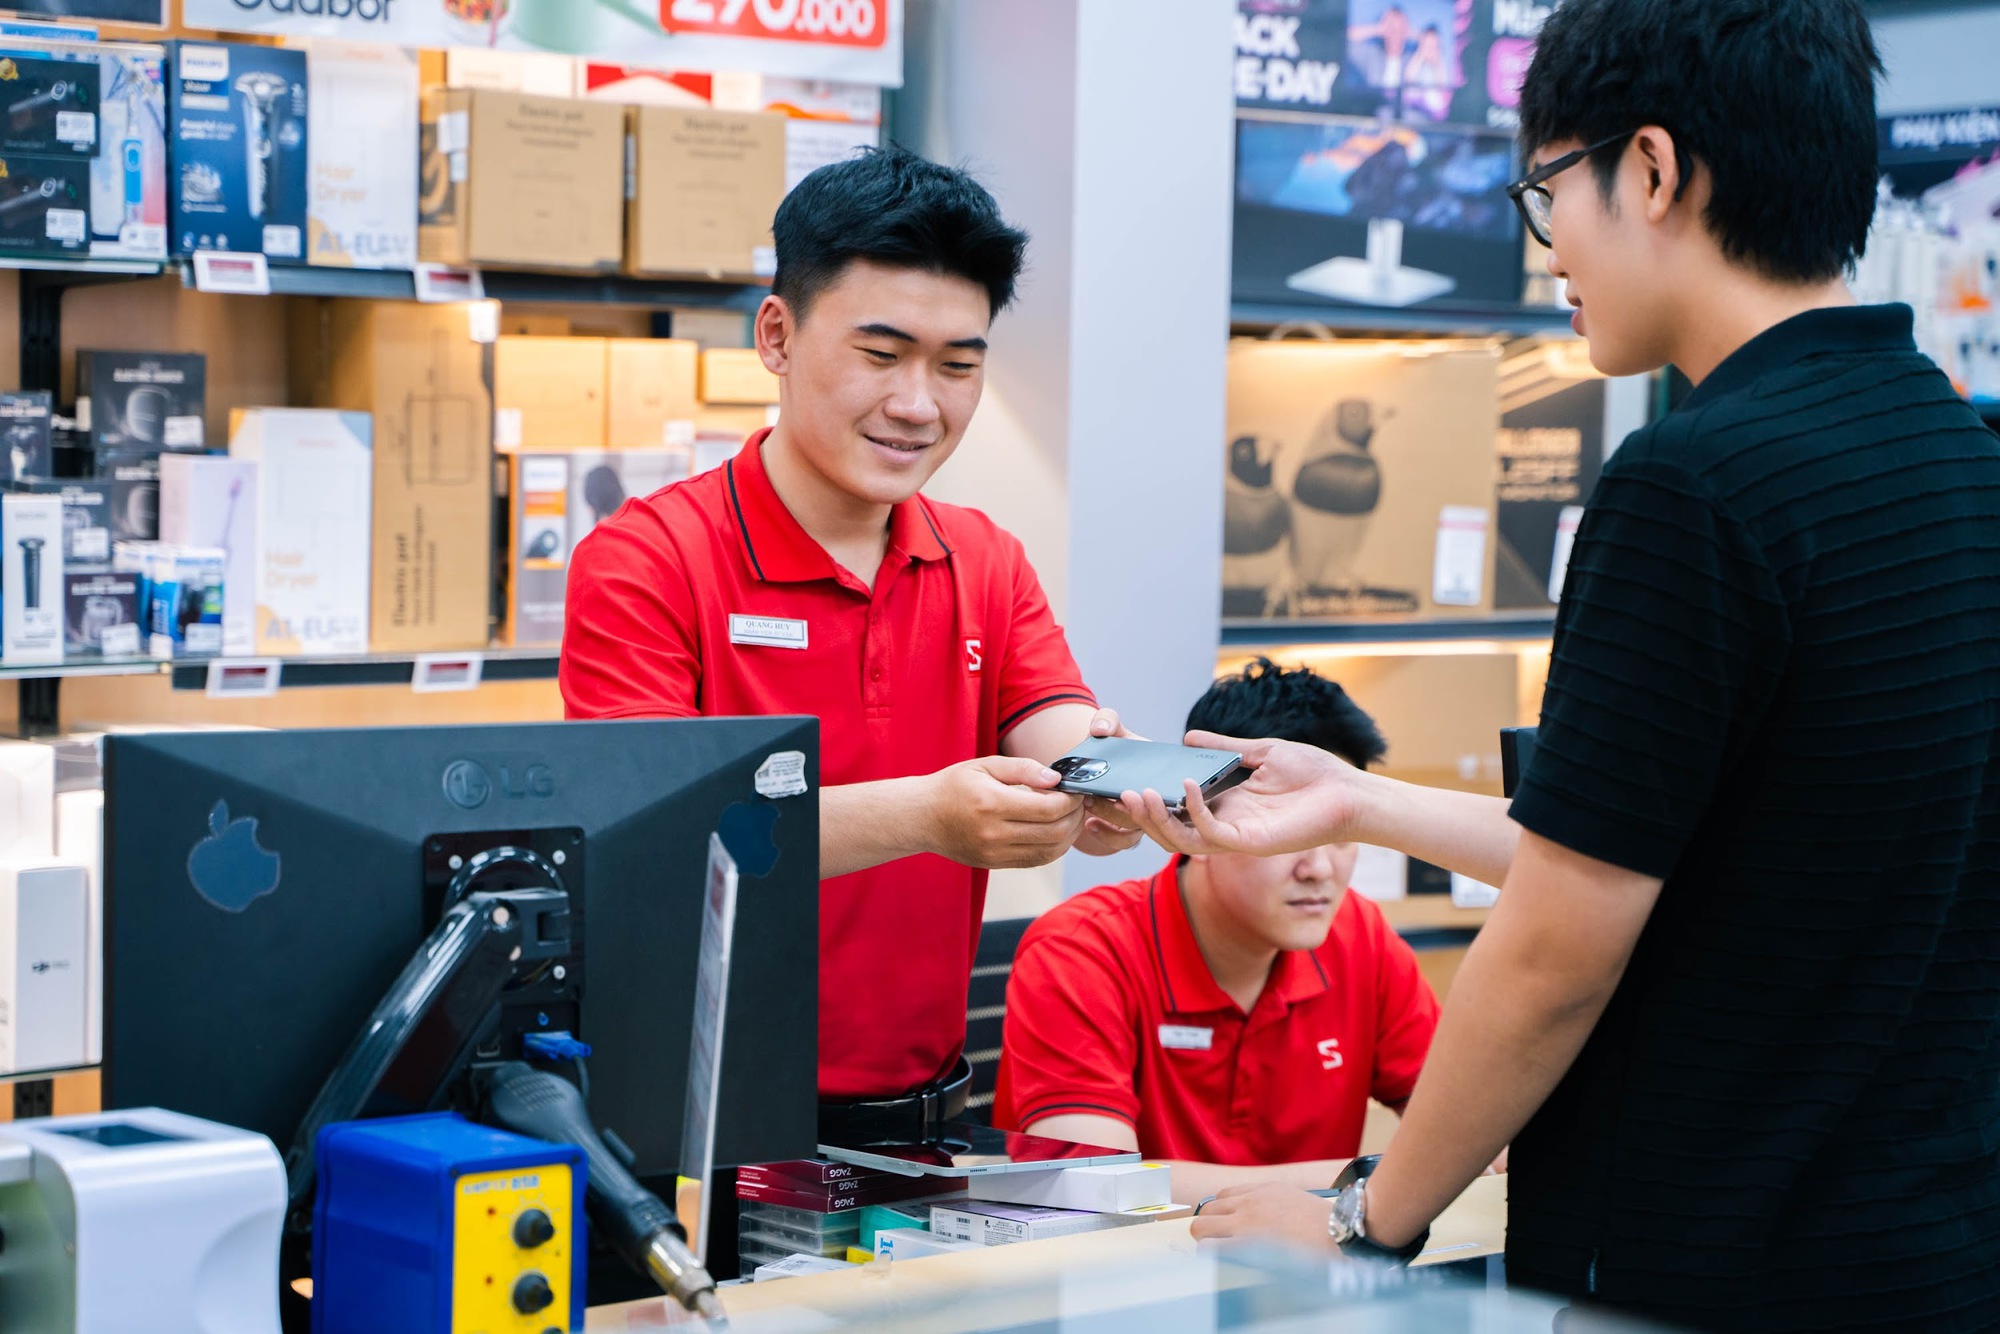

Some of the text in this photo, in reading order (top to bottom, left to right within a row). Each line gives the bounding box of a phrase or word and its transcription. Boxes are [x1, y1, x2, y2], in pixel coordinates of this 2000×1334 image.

[1234, 56, 1340, 105] E-DAY
[745, 620, 773, 629] QUANG
[500, 764, 555, 799] LG
[829, 1166, 852, 1178] ZAGG
[838, 1179, 859, 1191] ZAGG
[834, 1197, 855, 1208] ZAGG
